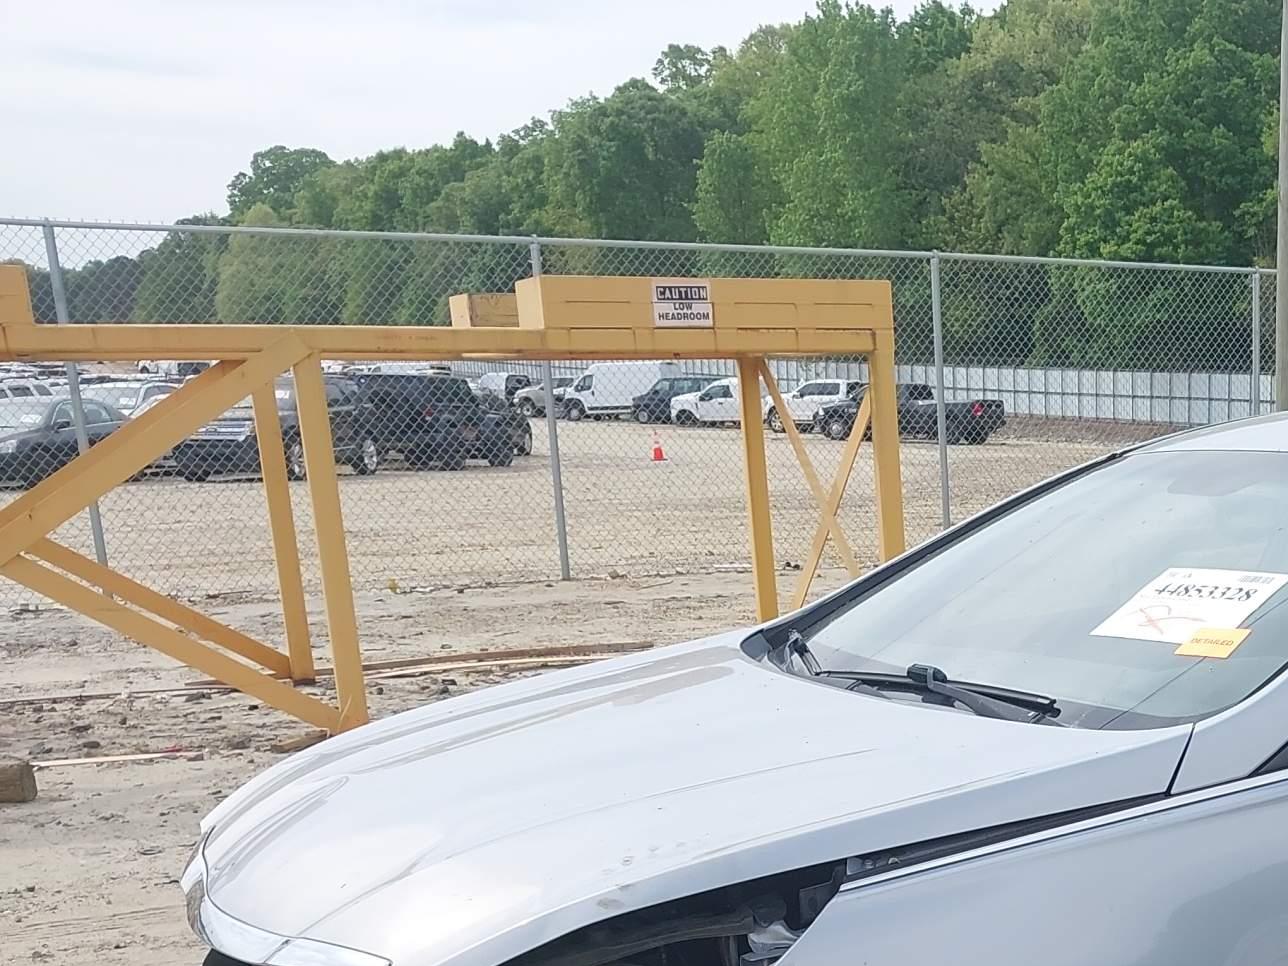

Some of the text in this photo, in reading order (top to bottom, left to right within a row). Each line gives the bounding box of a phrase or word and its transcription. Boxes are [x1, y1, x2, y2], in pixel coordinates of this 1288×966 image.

[656, 287, 707, 299] CAUTION
[673, 302, 693, 311] LOW
[658, 312, 710, 321] HEADROOM
[1154, 583, 1258, 602] 44853328
[1190, 637, 1234, 647] DETAILED
